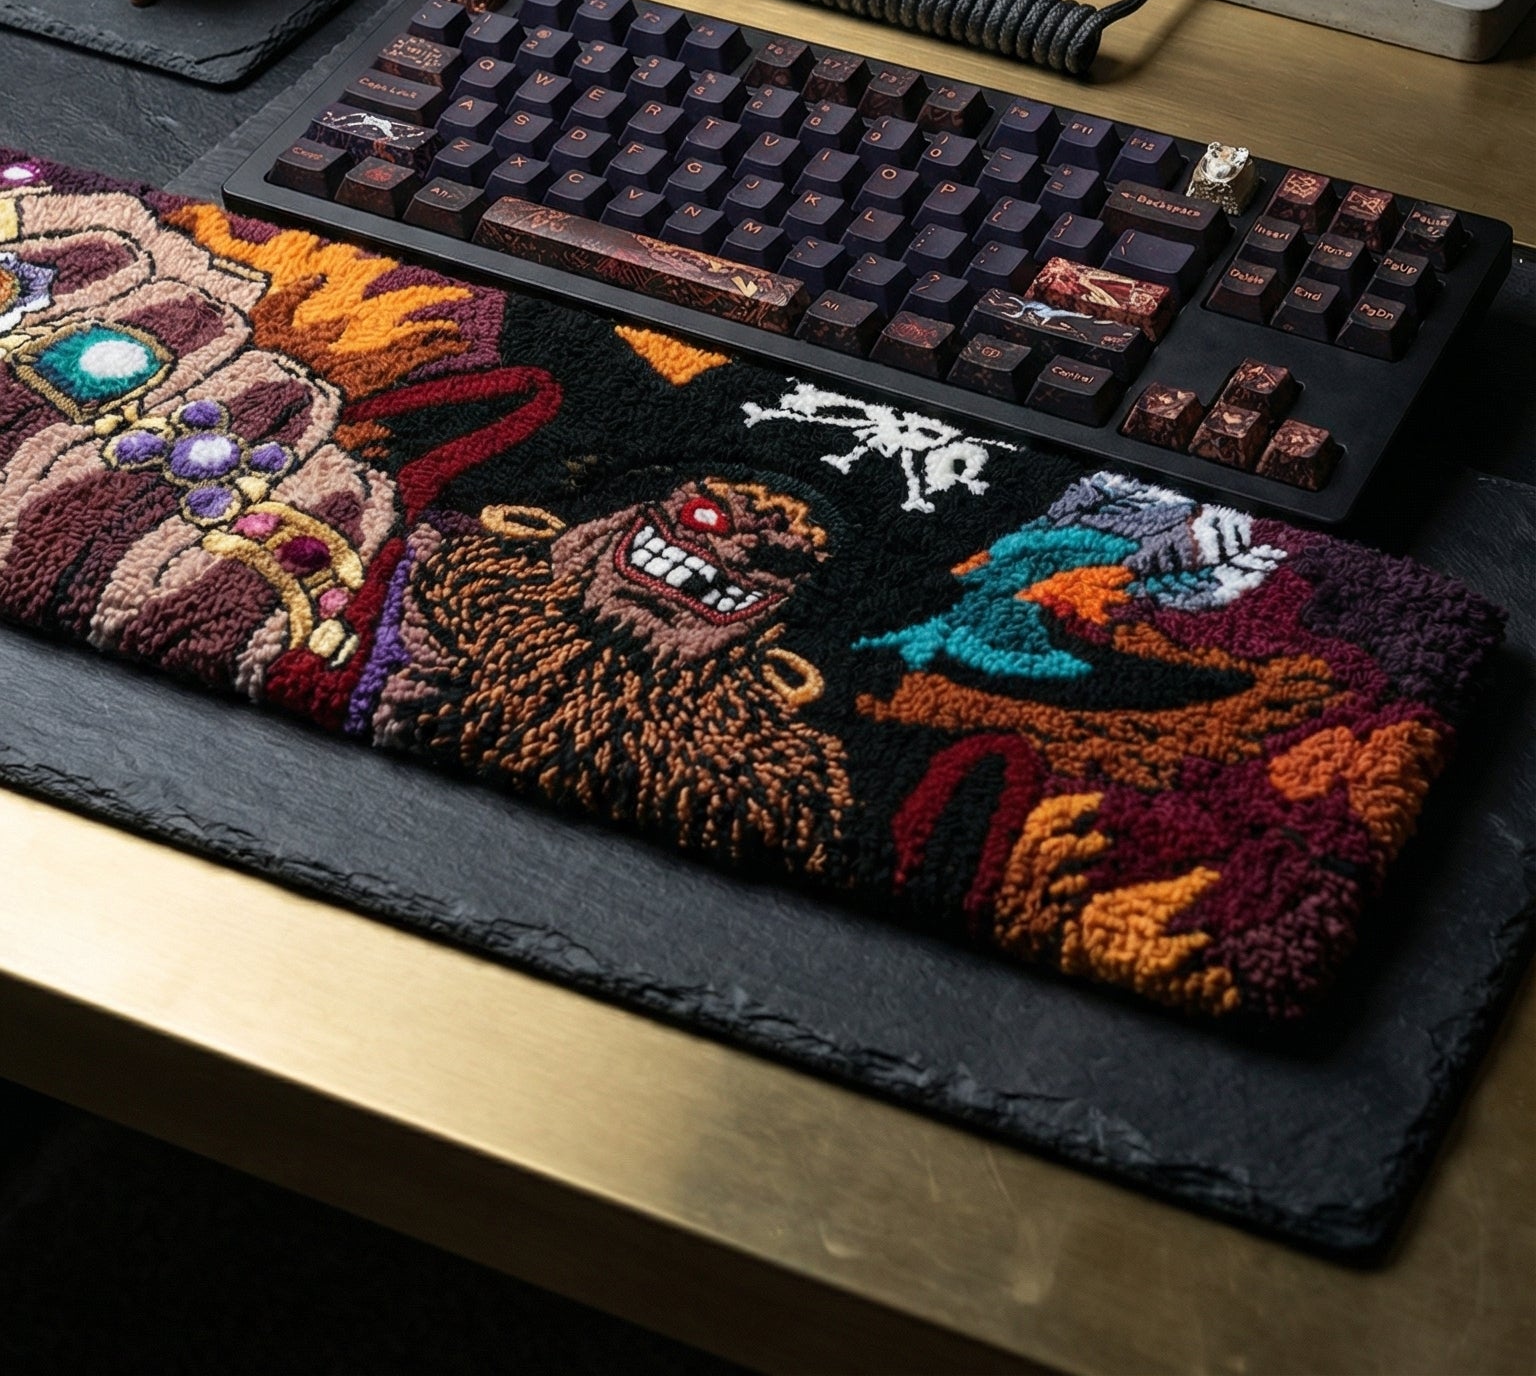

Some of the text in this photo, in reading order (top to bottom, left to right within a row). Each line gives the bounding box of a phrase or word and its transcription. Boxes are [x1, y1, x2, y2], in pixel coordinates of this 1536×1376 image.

[479, 60, 495, 70] Q
[535, 74, 555, 85] W
[588, 89, 606, 100] E
[458, 100, 474, 110] A
[645, 105, 662, 115] R
[514, 115, 530, 125] S
[705, 119, 720, 129] T
[570, 130, 587, 140] D
[452, 141, 471, 151] Z
[627, 145, 644, 153] F
[510, 157, 527, 167] X
[687, 163, 703, 173] G
[568, 174, 585, 183] C
[881, 169, 897, 179] O
[746, 180, 760, 188] J
[940, 184, 957, 192] P
[629, 190, 644, 198] V
[804, 194, 821, 205] K
[684, 207, 702, 216] N
[863, 211, 875, 222] L
[743, 222, 762, 233] M
[1294, 287, 1322, 300] End
[1360, 304, 1394, 319] PgDn
